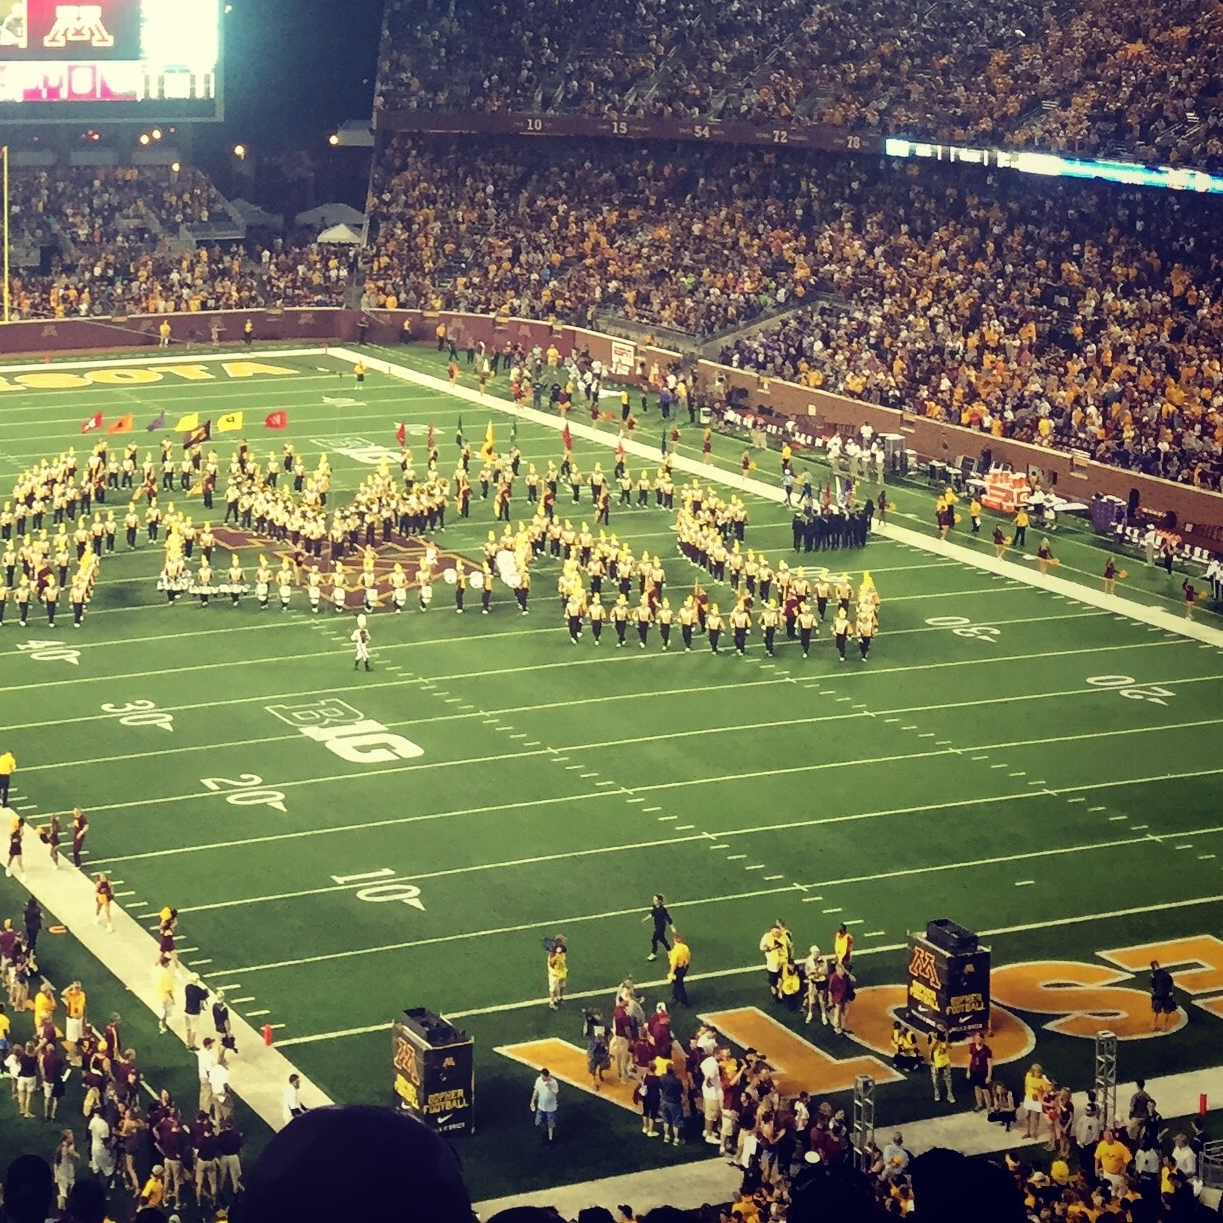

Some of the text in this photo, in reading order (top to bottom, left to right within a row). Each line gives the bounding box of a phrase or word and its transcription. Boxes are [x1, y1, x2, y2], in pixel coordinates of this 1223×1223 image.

[527, 118, 542, 131] 10
[694, 125, 709, 138] 54
[773, 129, 788, 143] 72
[16, 639, 81, 663] 40
[100, 699, 175, 730] 30
[200, 773, 287, 810] 20
[330, 867, 422, 907] 10
